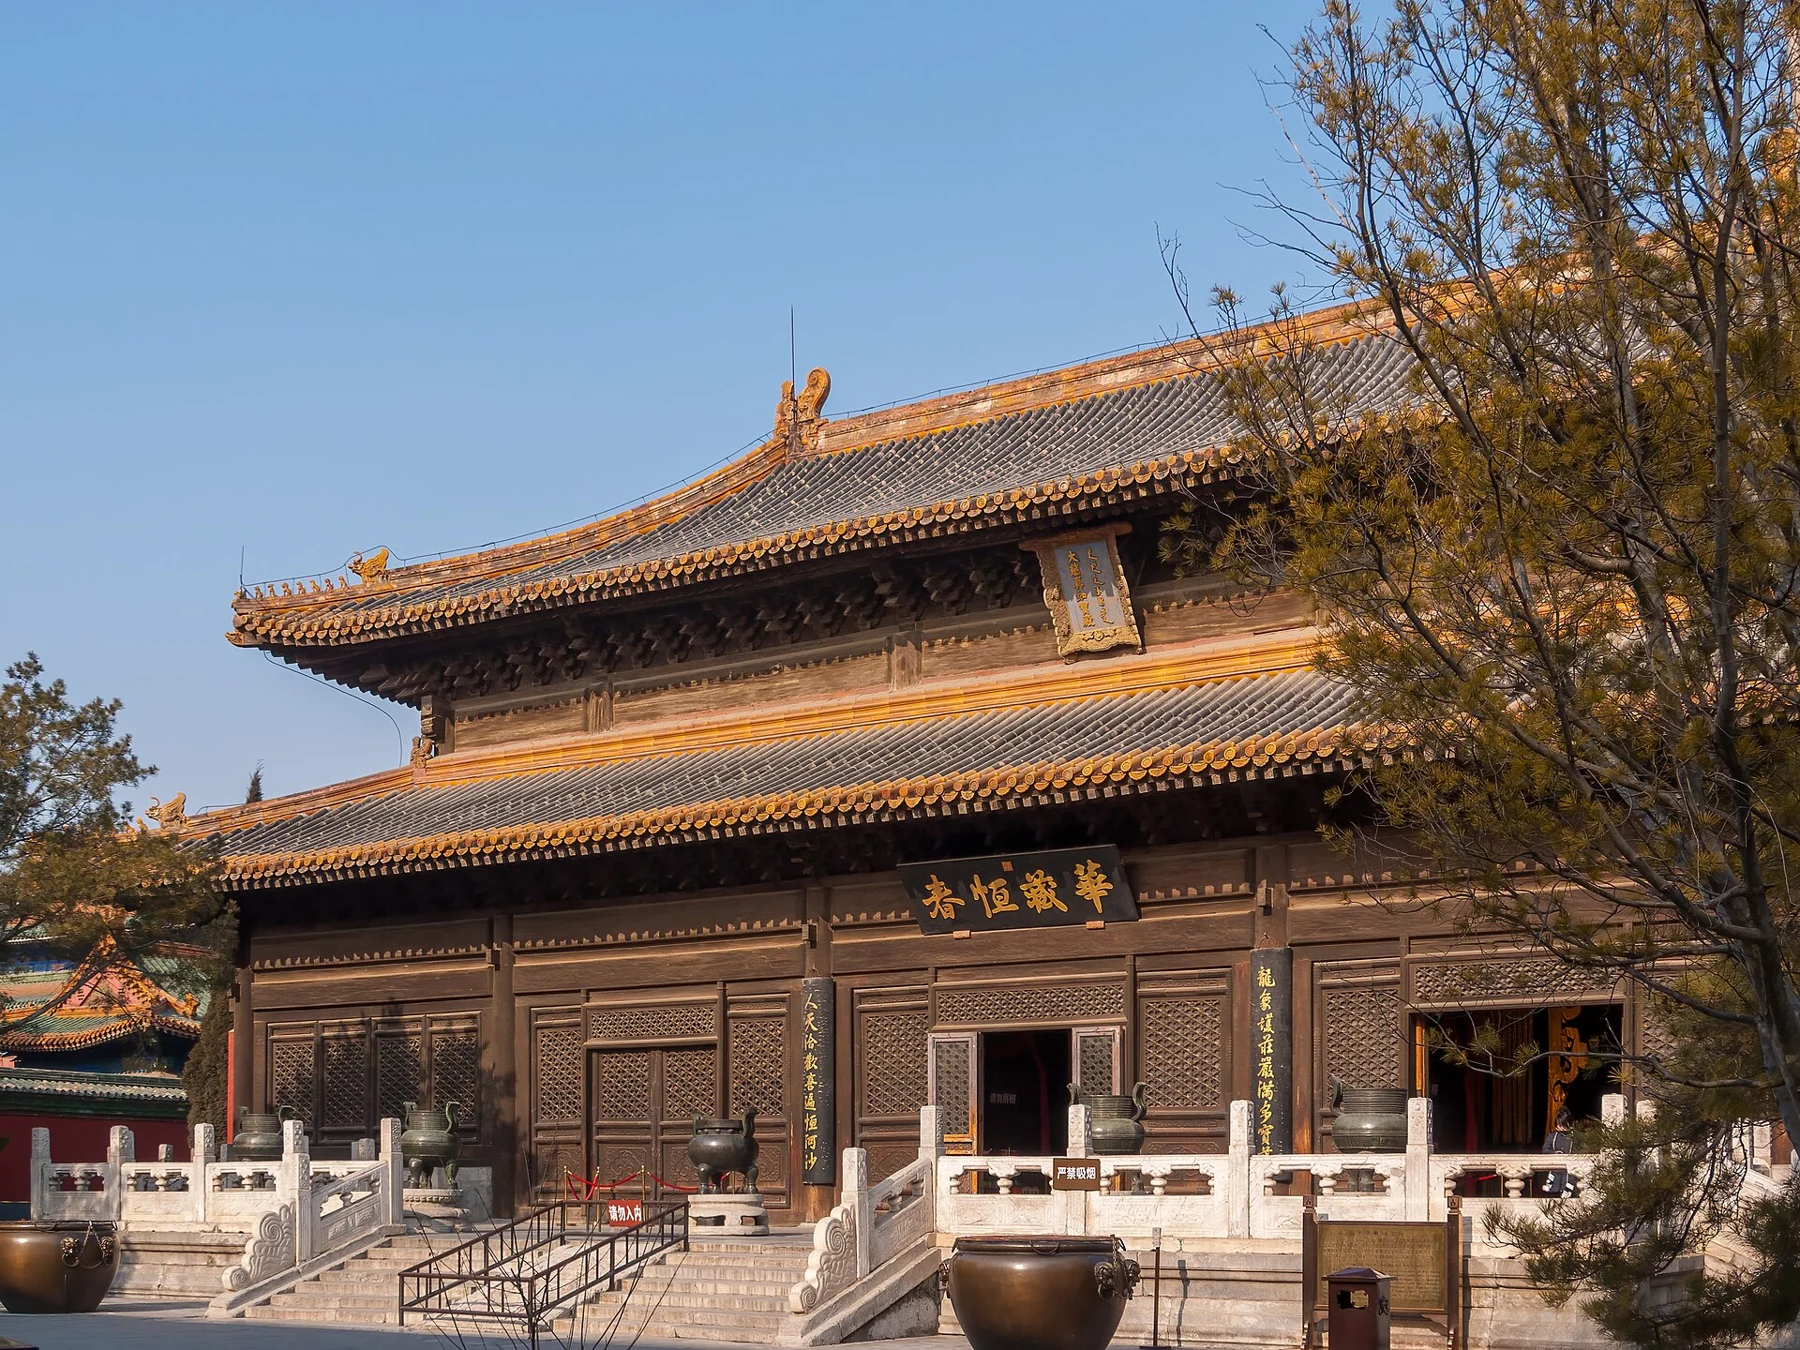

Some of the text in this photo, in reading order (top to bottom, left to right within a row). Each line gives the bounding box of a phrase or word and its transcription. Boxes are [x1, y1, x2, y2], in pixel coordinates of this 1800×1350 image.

[1057, 1166, 1096, 1180] 严禁吸烟
[608, 1204, 642, 1222] 请勿入内
